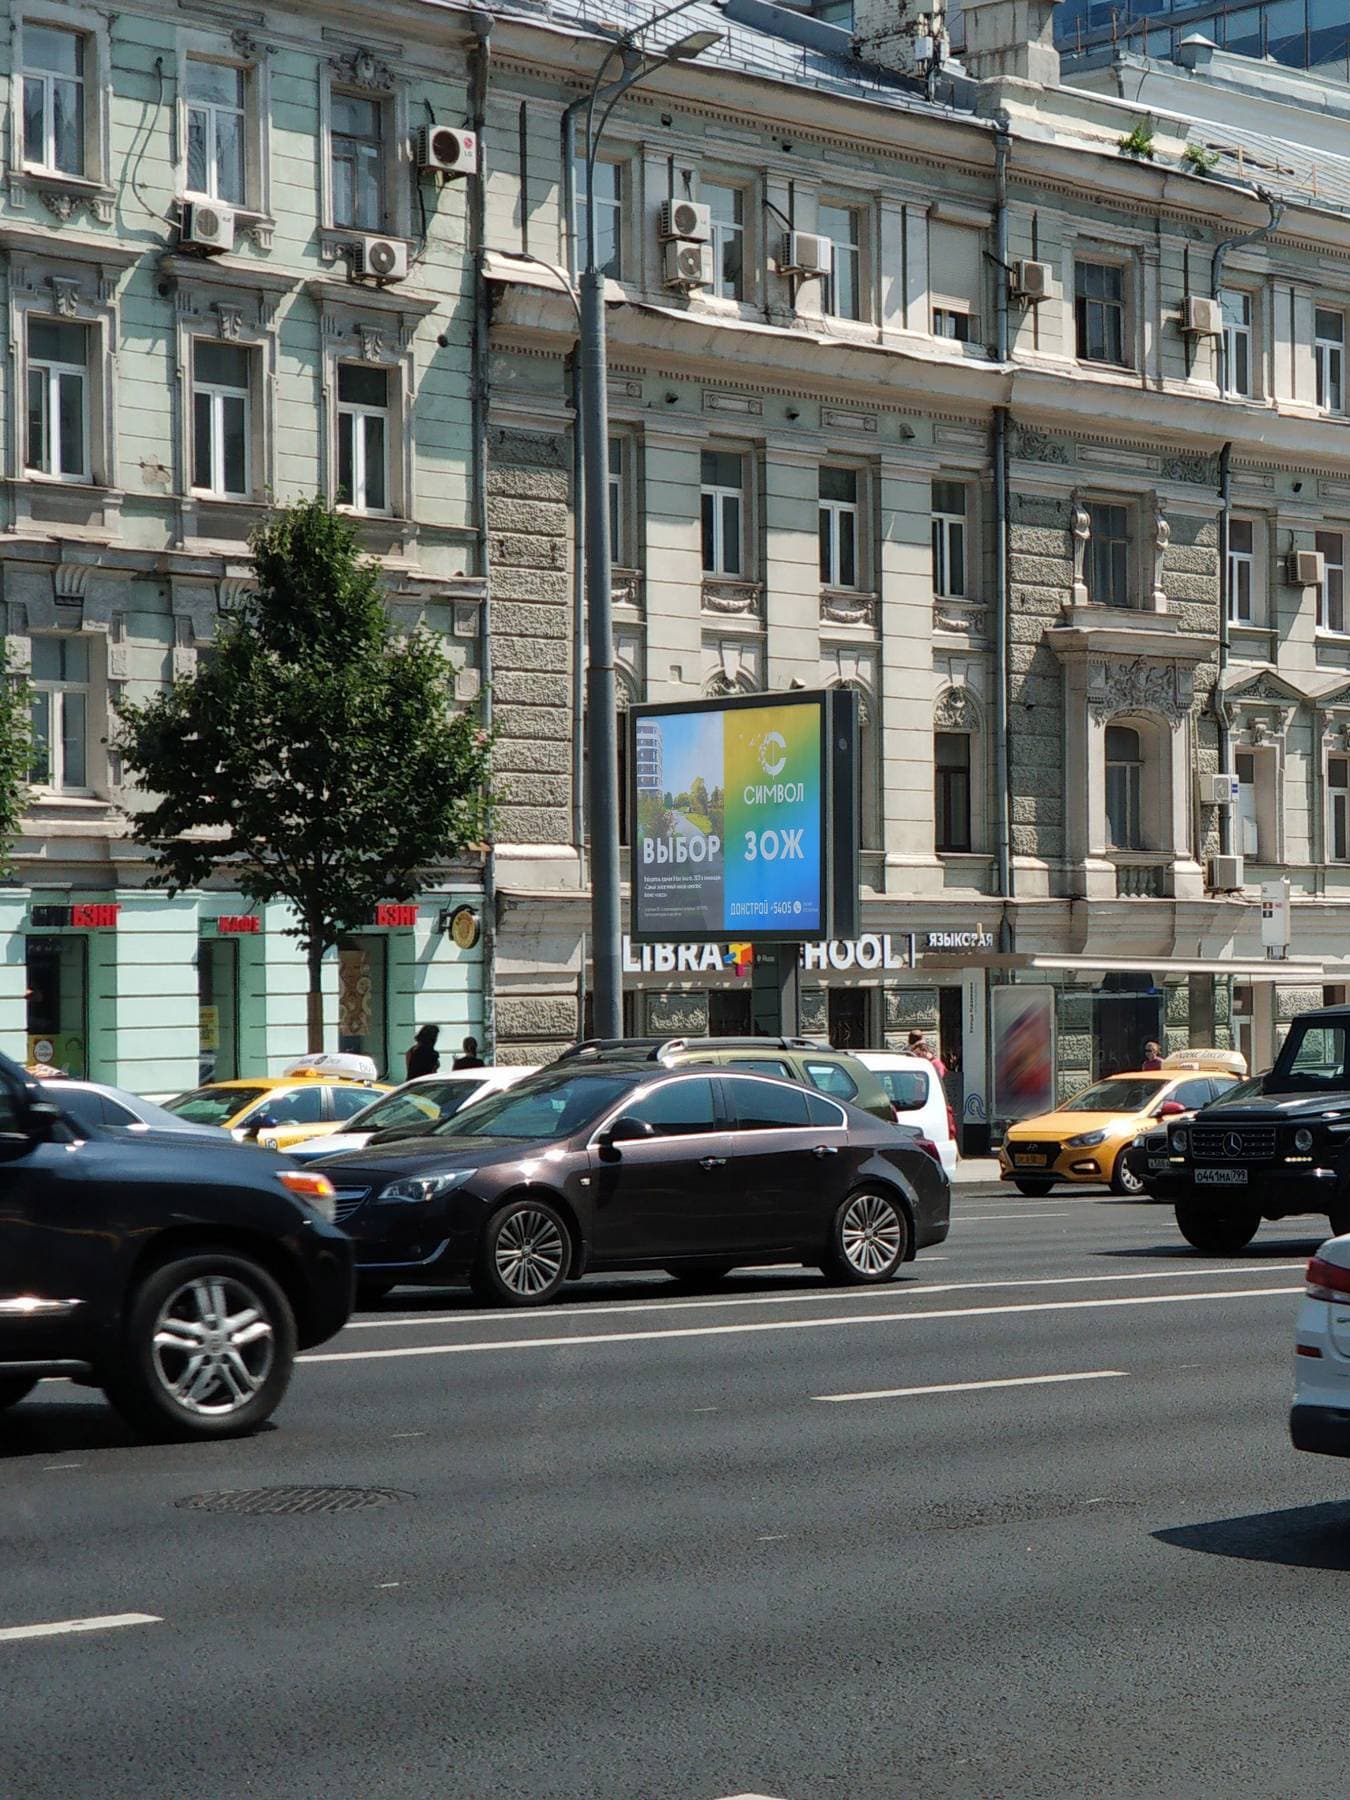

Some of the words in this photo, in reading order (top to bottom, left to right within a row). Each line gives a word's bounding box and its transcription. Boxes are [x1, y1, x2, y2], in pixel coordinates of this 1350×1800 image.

[743, 782, 805, 806] СИМВОЛ
[642, 834, 721, 864] ВЫБОР
[744, 828, 805, 862] ЗОЖ
[730, 899, 769, 916] ДОНСТРОЙ
[622, 935, 724, 972] LIBRA
